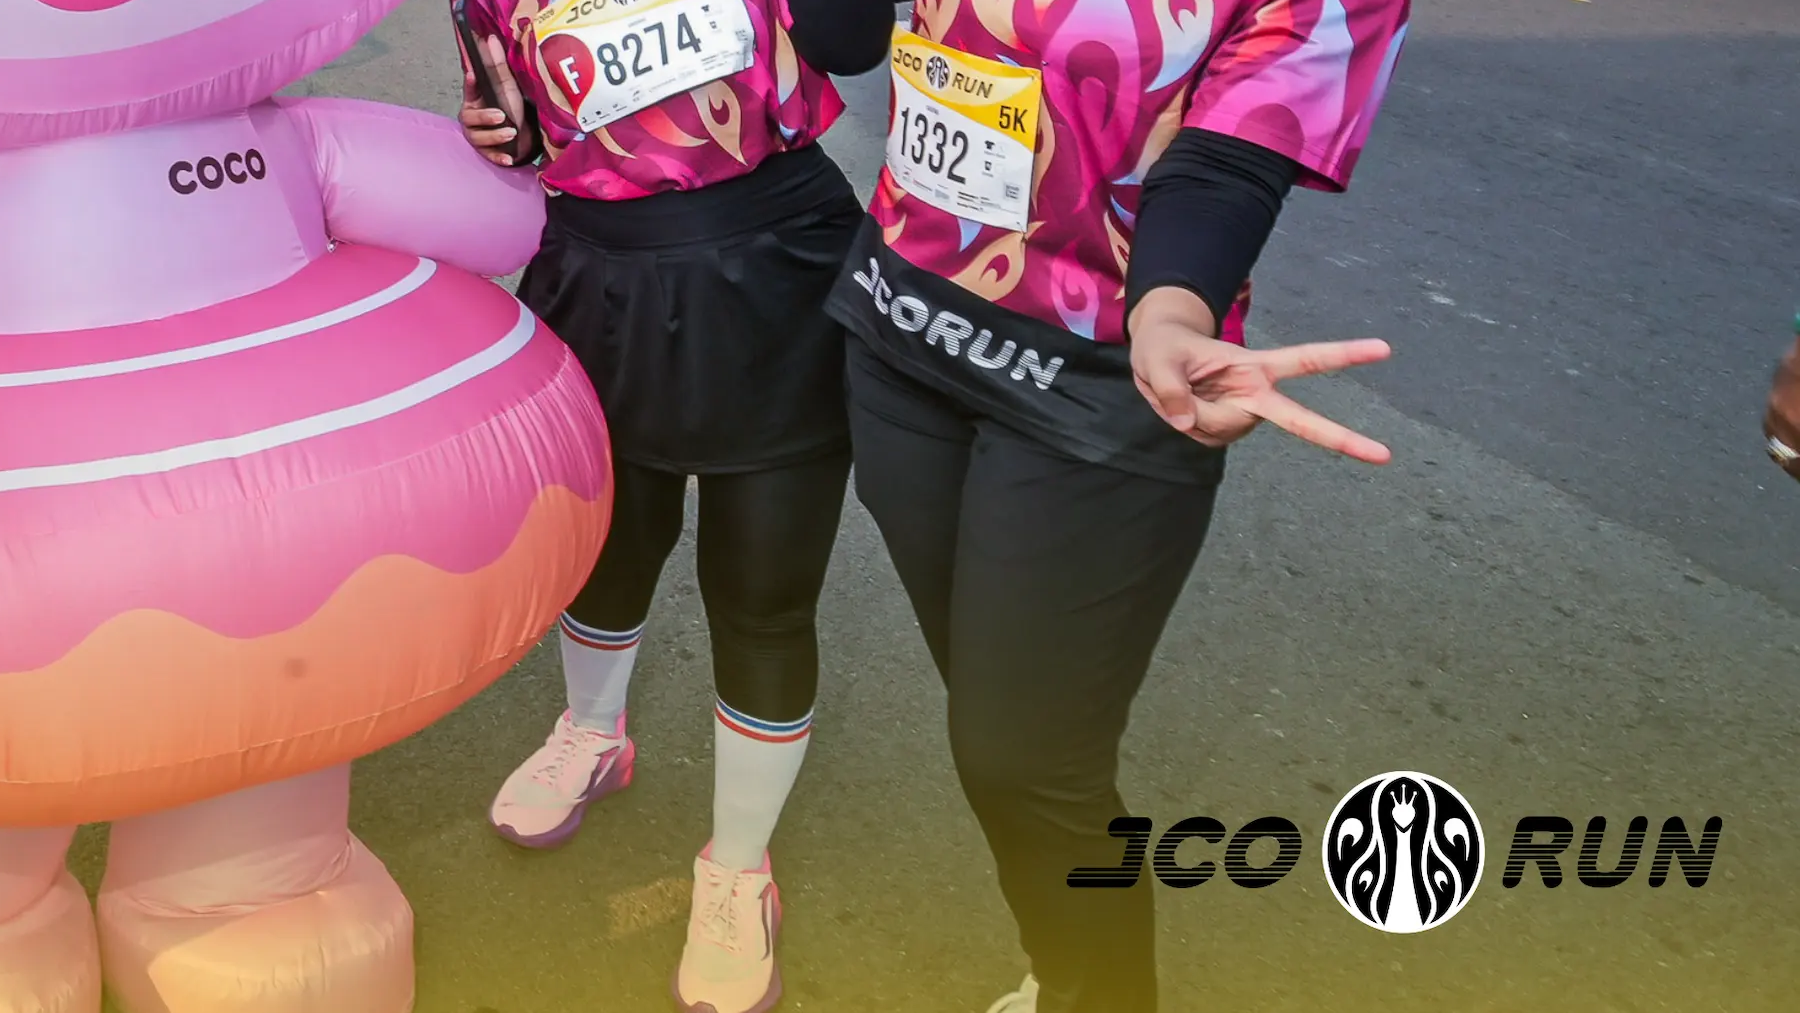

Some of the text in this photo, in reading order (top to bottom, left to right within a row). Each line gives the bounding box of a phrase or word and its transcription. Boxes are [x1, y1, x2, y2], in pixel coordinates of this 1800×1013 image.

[558, 56, 580, 95] F
[596, 12, 702, 87] 8274
[893, 48, 1029, 134] JCO RUN 5K
[168, 148, 266, 195] COCO
[900, 106, 969, 186] 1332
